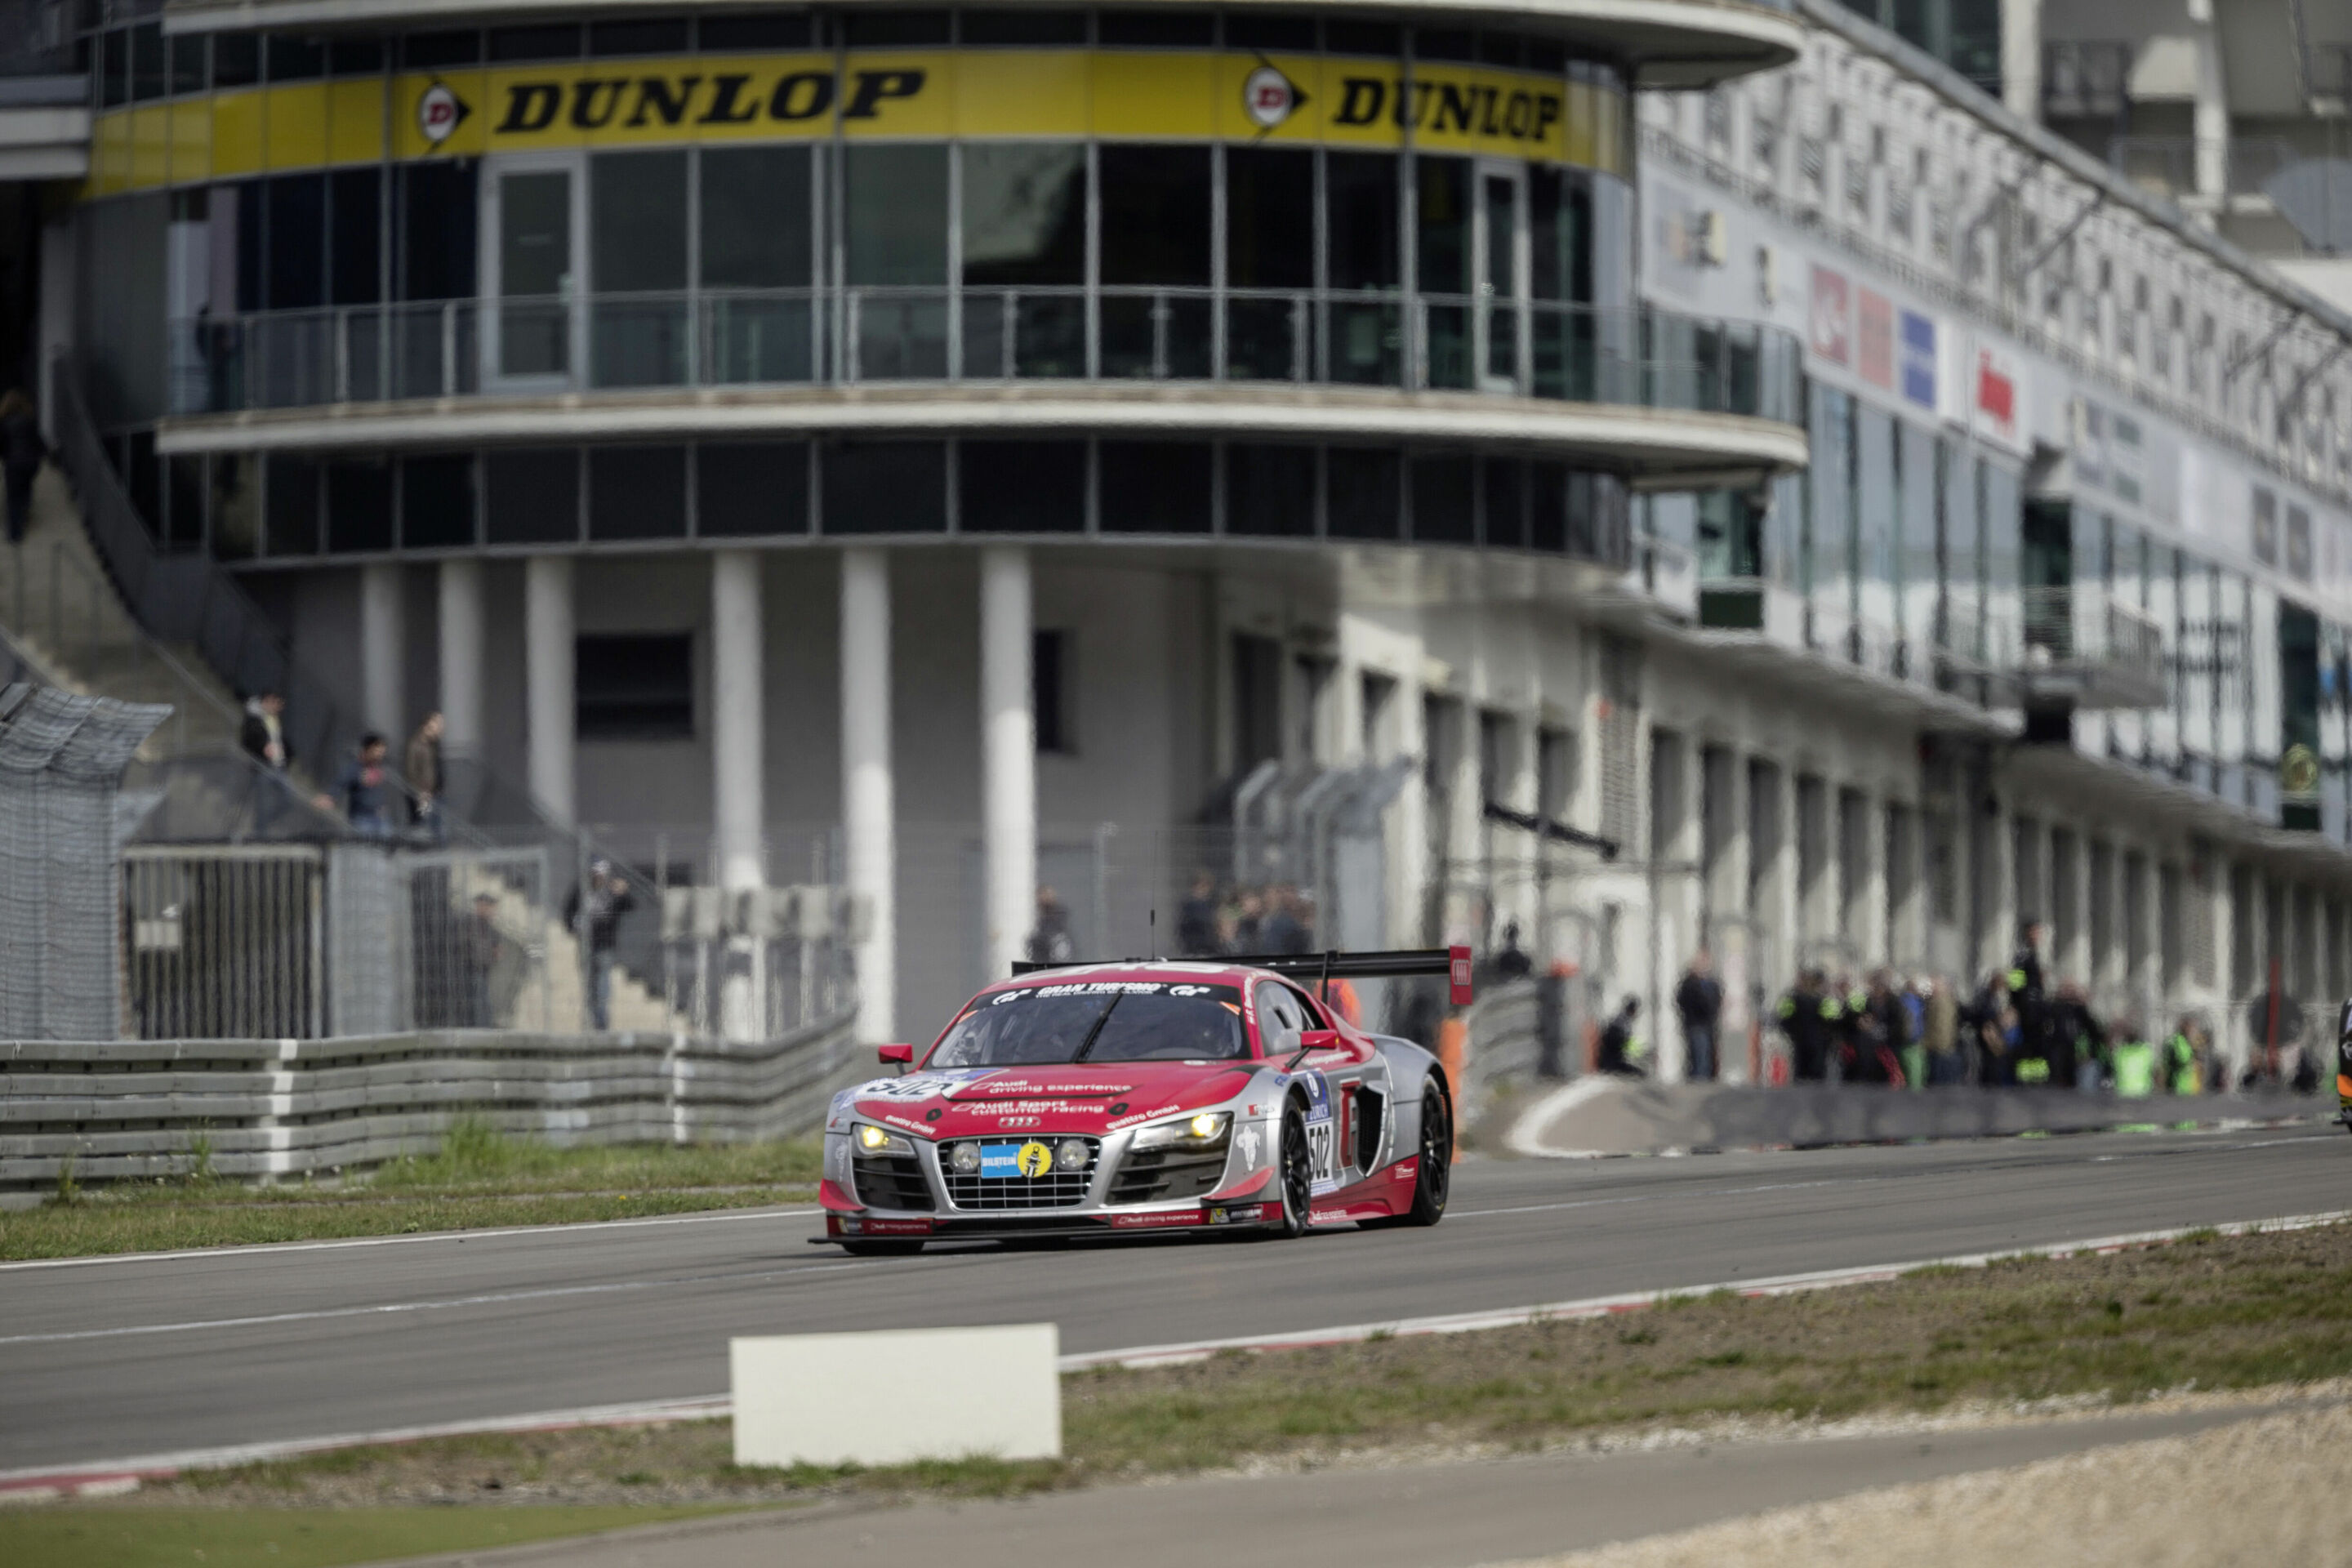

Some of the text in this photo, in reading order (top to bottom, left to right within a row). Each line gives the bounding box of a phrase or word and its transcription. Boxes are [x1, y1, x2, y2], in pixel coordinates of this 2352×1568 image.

[494, 69, 924, 134] DUNLOP
[1333, 78, 1560, 142] DUNLOP
[1037, 983, 1087, 996] GRAN
[989, 1084, 1132, 1094] driving experience
[971, 1105, 1104, 1116] customer racing
[973, 1100, 1067, 1111] Audi Sport
[1106, 1104, 1180, 1129] quattro GmbH
[1308, 1125, 1330, 1181] 502
[982, 1156, 1017, 1167] BILSTEIN
